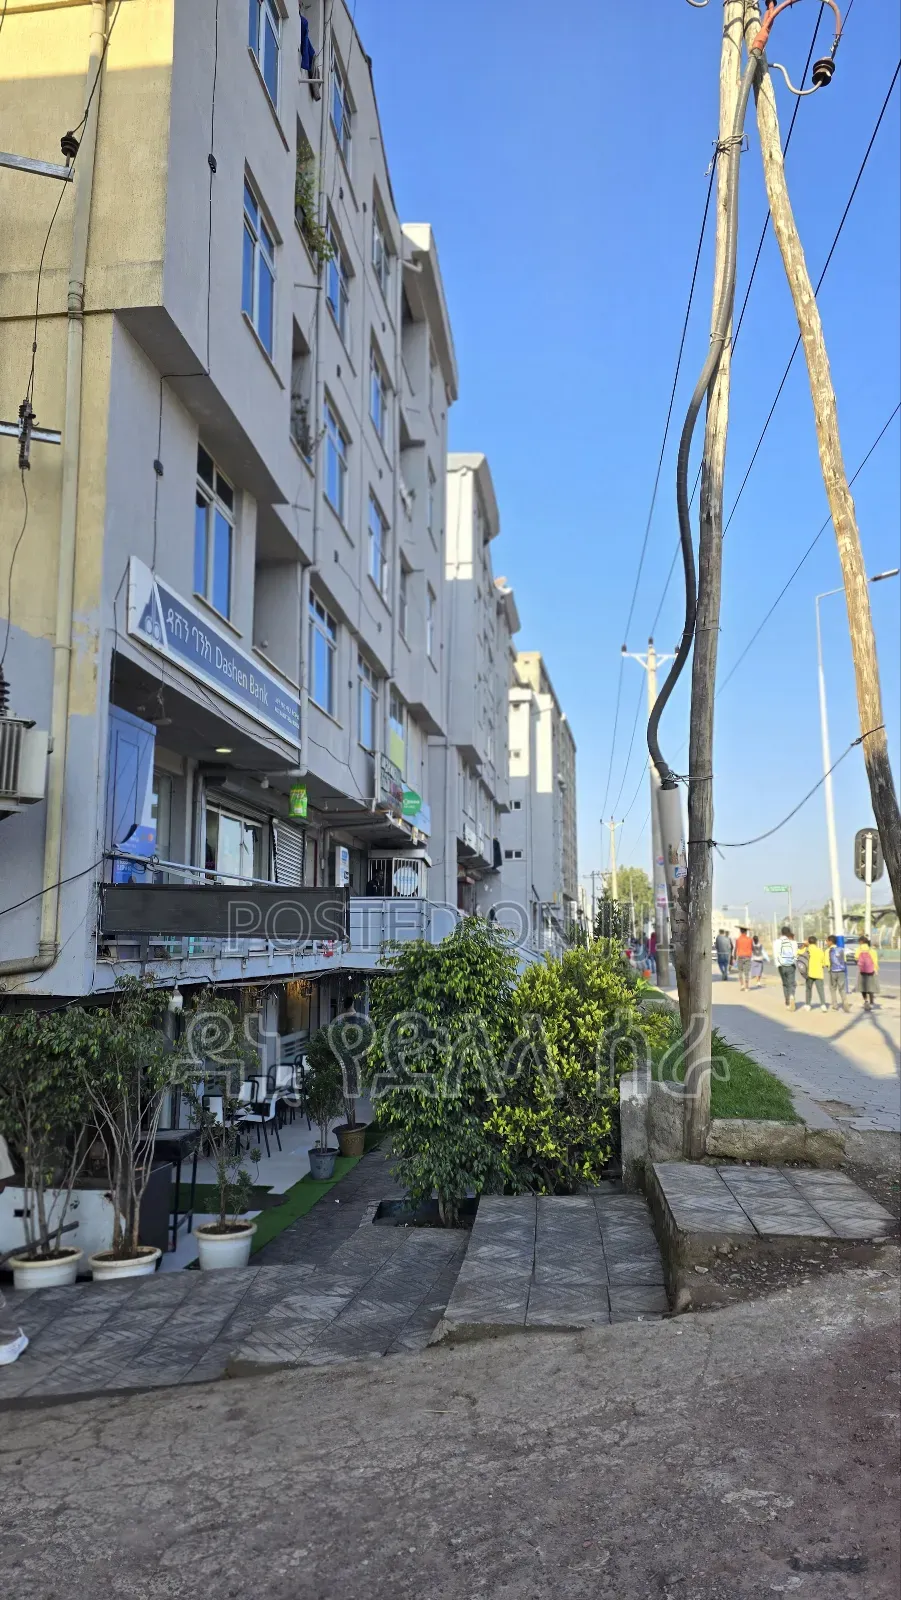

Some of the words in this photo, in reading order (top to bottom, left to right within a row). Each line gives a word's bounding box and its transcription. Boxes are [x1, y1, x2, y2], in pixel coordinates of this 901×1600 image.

[191, 626, 211, 664] ባንክ
[215, 646, 248, 690] Dashen
[249, 673, 268, 706] Bank
